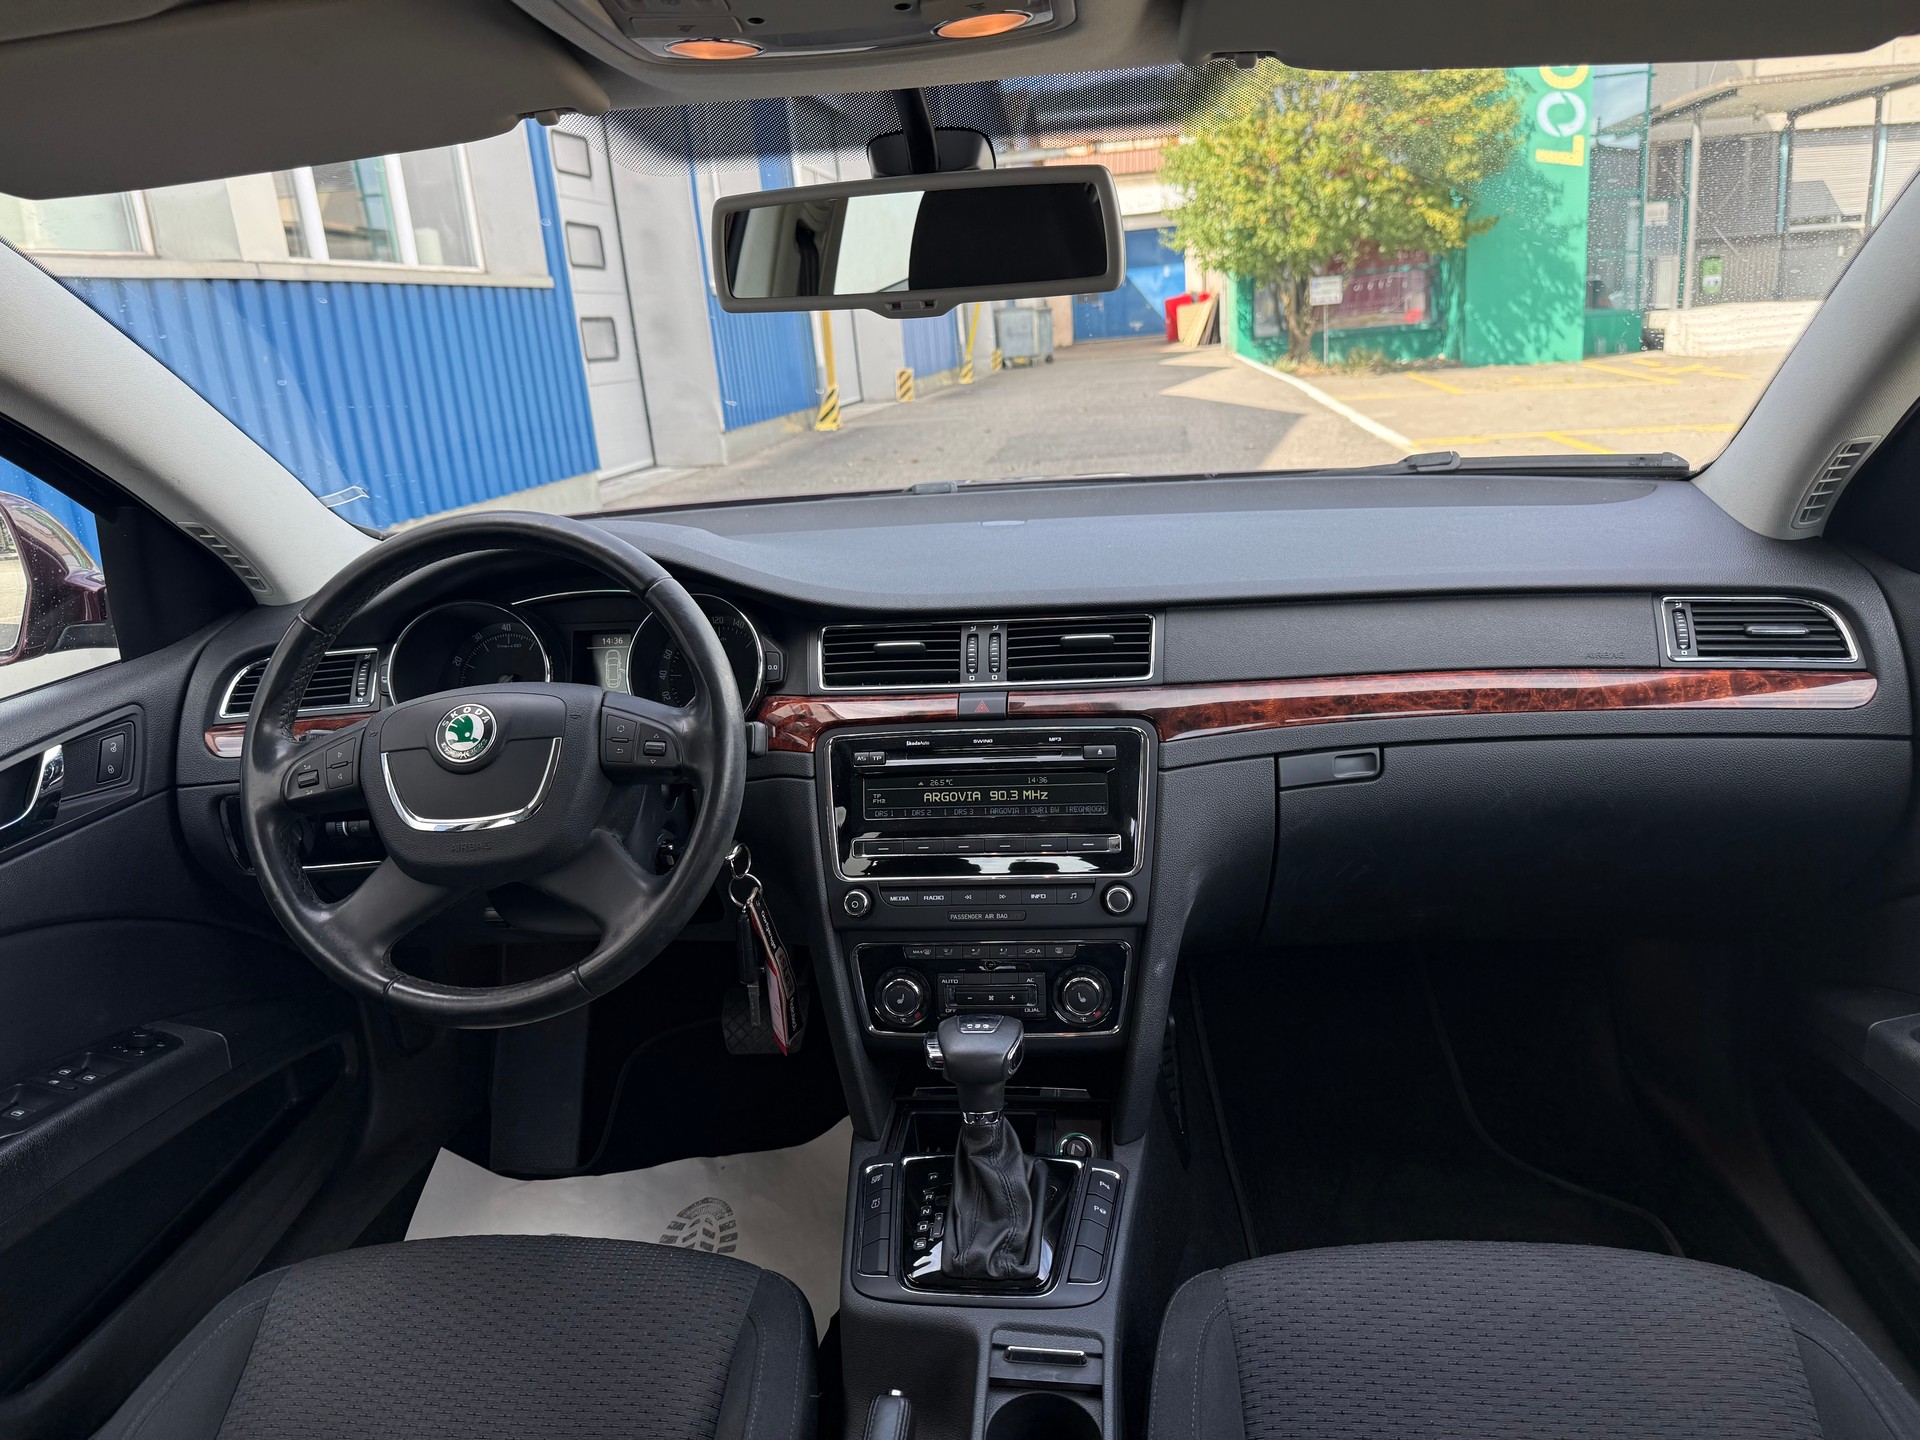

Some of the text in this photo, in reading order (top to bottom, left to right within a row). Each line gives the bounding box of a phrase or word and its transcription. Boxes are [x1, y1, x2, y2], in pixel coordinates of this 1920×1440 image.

[501, 623, 512, 632] 40
[732, 618, 745, 629] 140
[472, 632, 483, 643] 30
[602, 637, 624, 645] 14:36
[663, 649, 673, 660] 60
[452, 655, 463, 667] 20
[659, 670, 668, 680] 40
[1027, 776, 1048, 784] 14:36
[923, 789, 1049, 803] ARGOVIA 90.3 MHz
